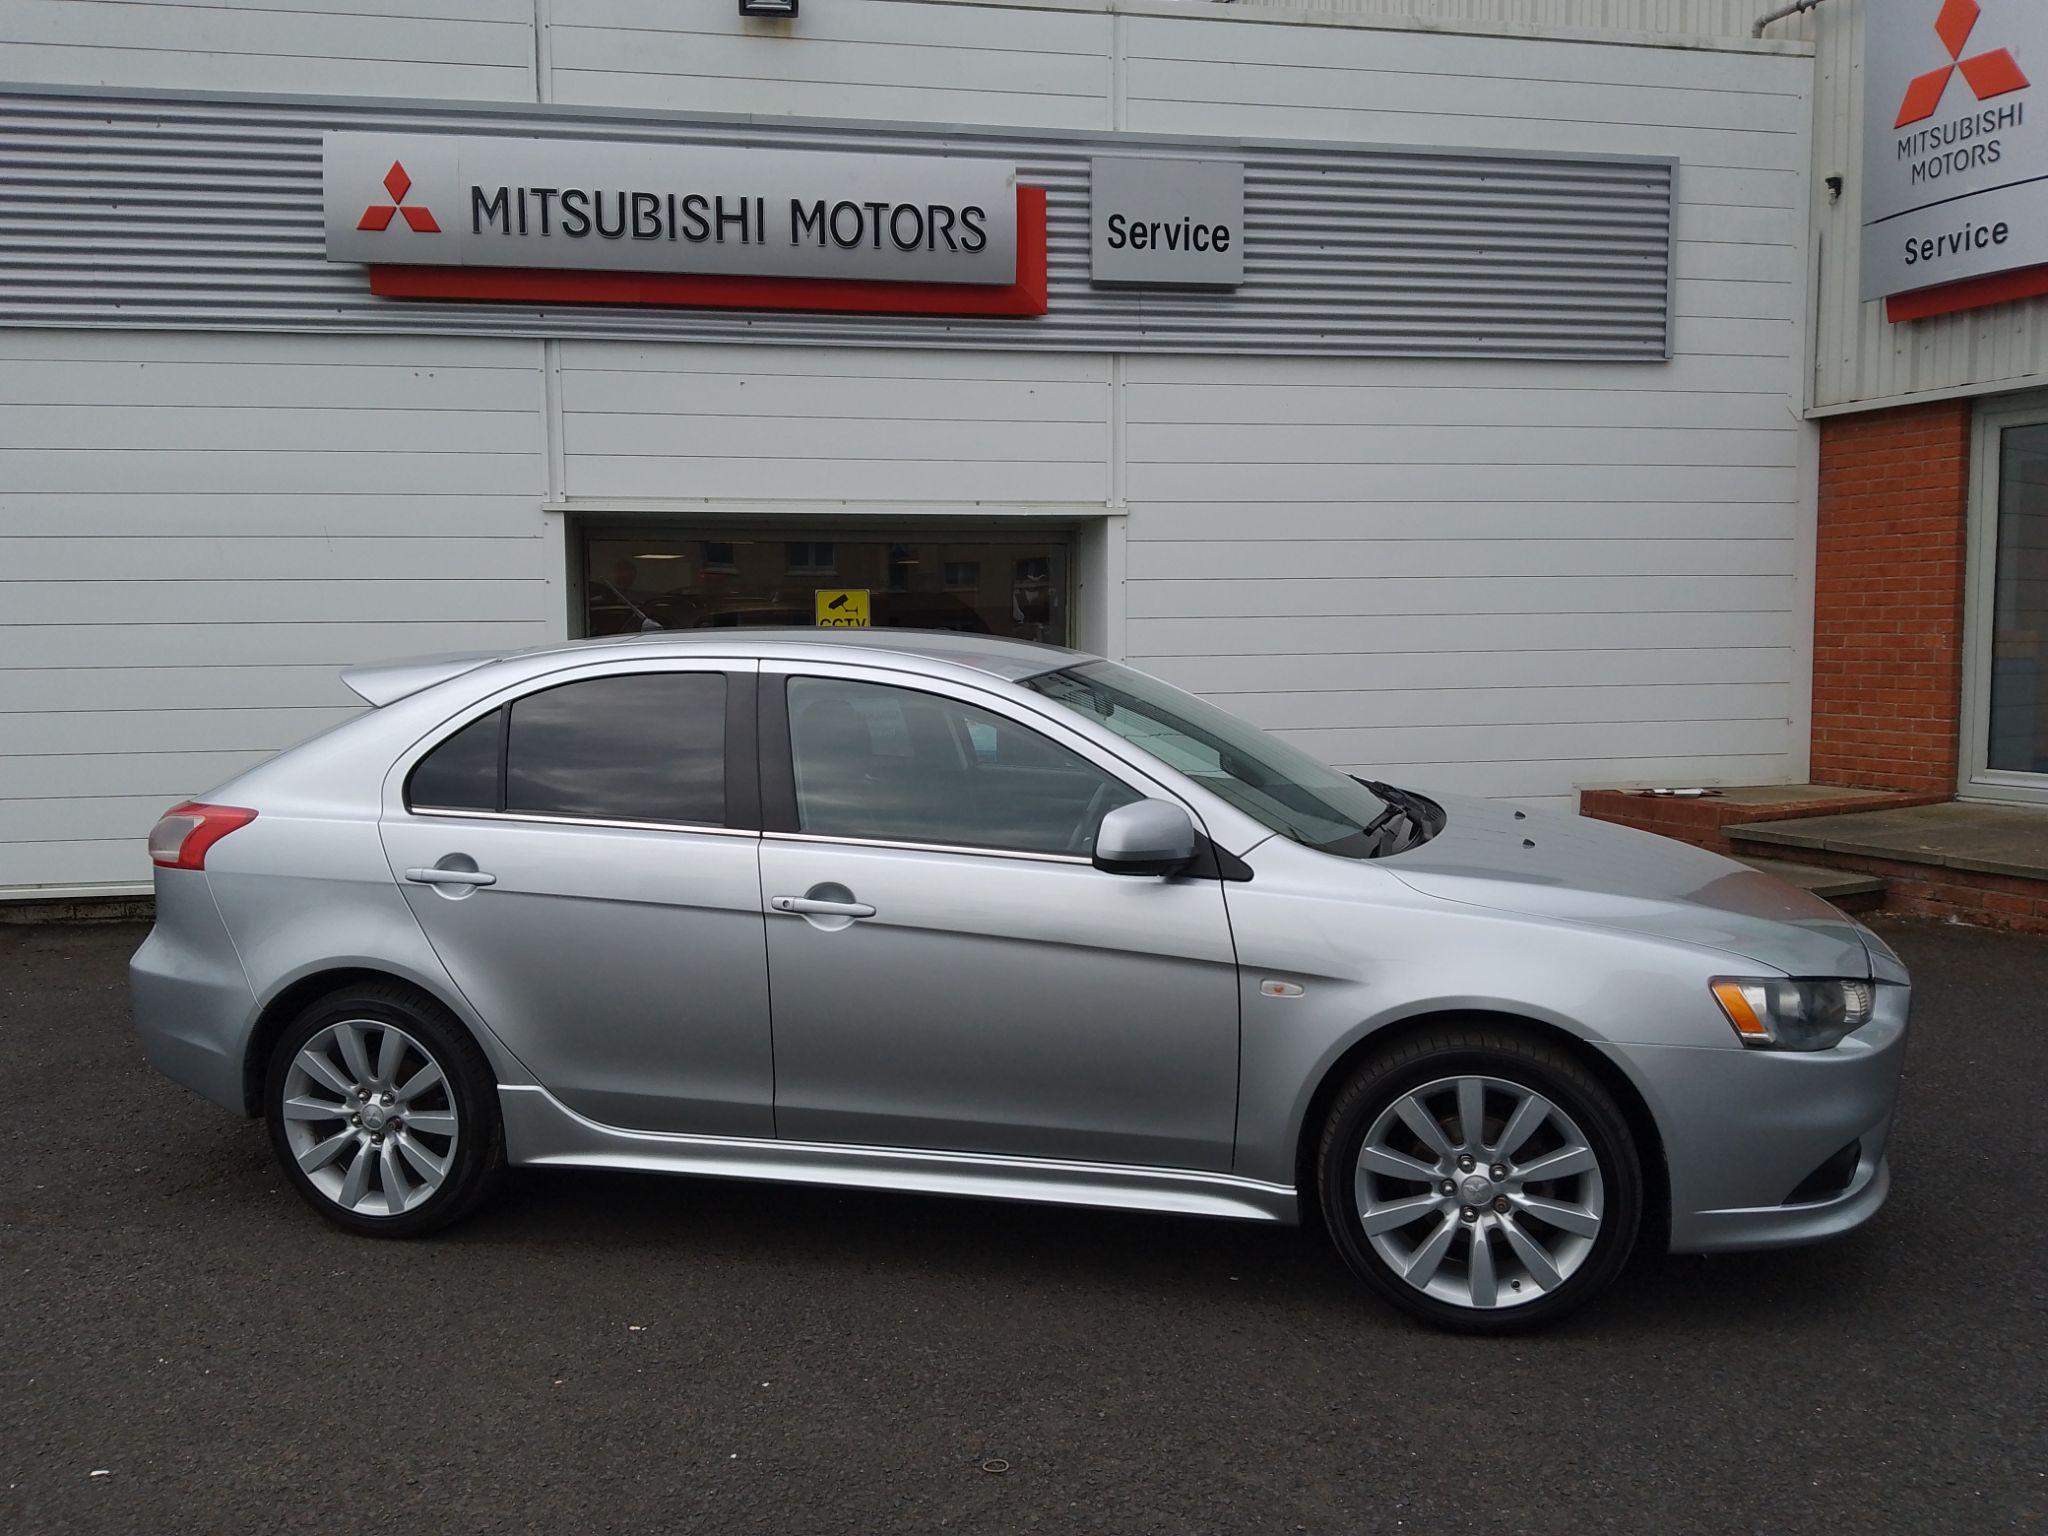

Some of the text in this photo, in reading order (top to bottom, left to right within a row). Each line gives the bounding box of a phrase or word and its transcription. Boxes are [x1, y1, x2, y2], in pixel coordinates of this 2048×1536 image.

[1897, 102, 2023, 160] MITSUBISHI
[1911, 140, 2001, 185] MOTORS
[471, 184, 987, 253] MITSUBISHI MOTORS
[1107, 213, 1230, 253] Service
[1904, 221, 2009, 265] Service
